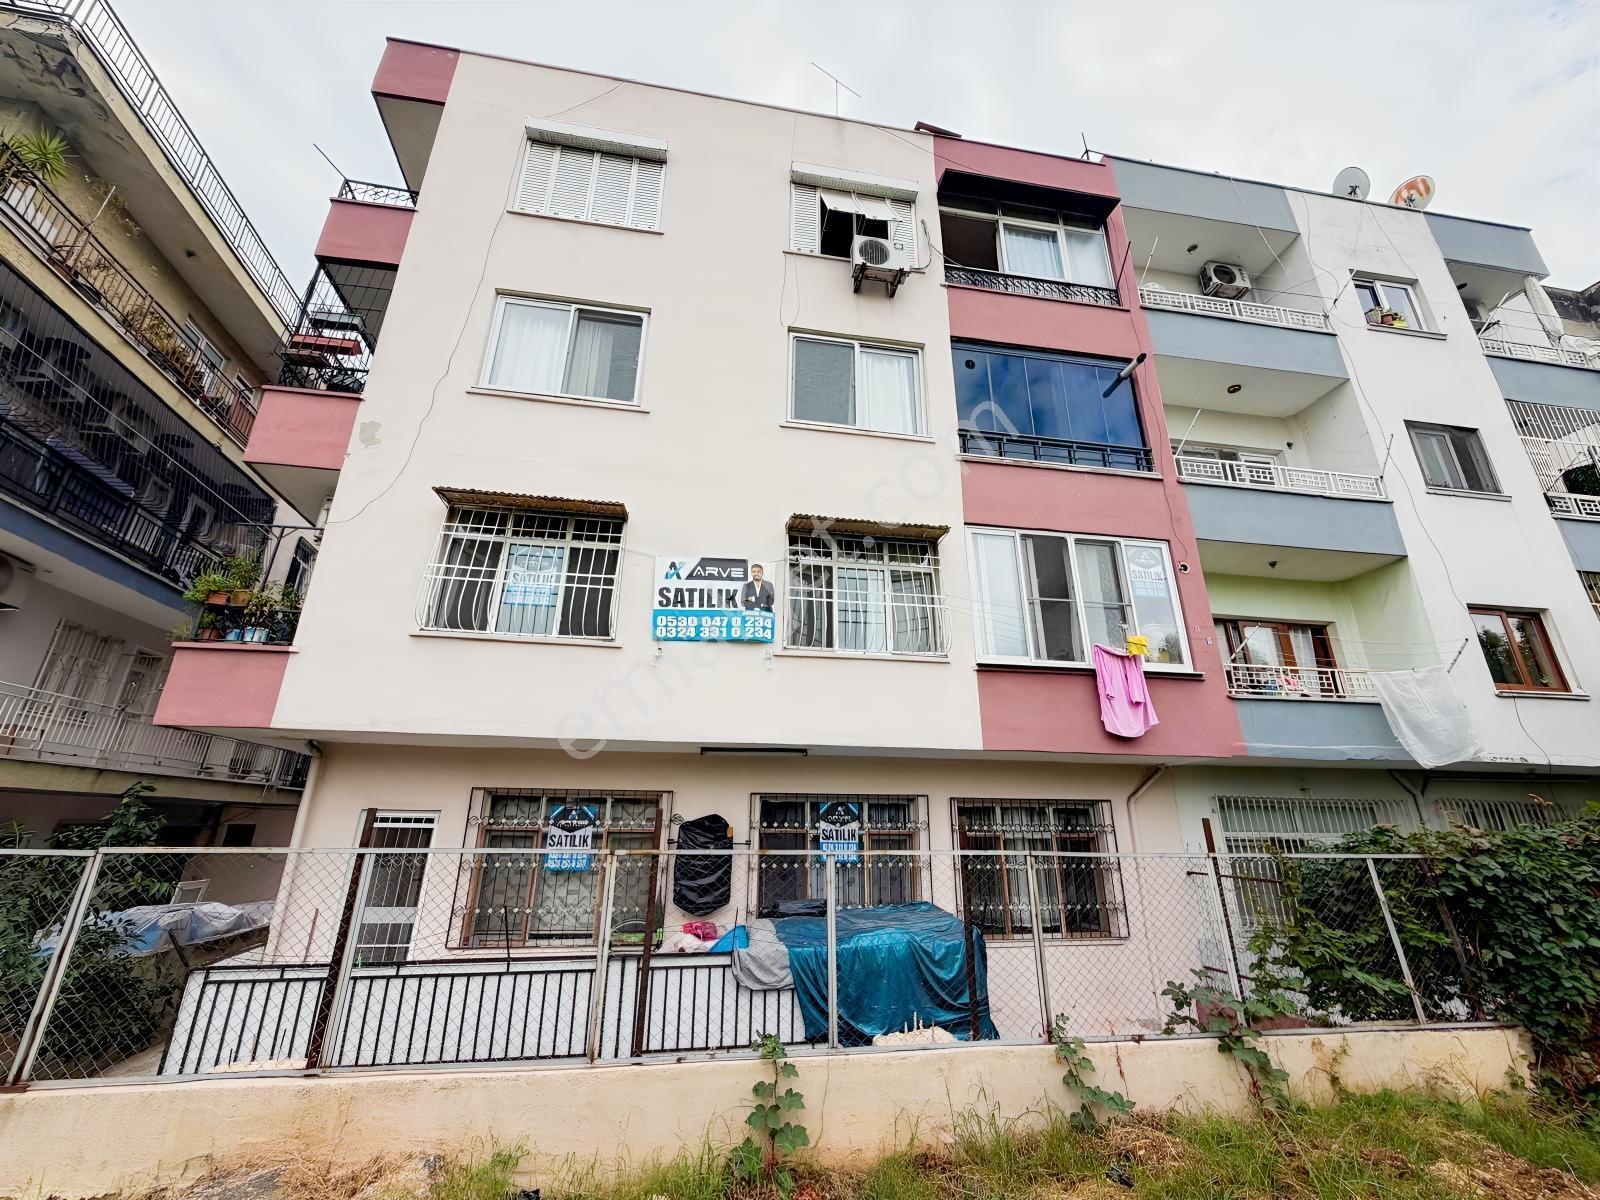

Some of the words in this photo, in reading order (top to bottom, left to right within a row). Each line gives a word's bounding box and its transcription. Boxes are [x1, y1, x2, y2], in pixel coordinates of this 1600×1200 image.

[692, 566, 745, 578] ARVE
[658, 586, 739, 609] SATILIK
[656, 615, 698, 627] 0530
[701, 616, 729, 628] 047
[731, 616, 742, 628] 0
[744, 617, 772, 630] 234
[656, 627, 696, 638] 0324
[699, 627, 727, 638] 331
[730, 627, 741, 638] 0
[744, 627, 772, 640] 234
[548, 834, 590, 848] SATILIK
[821, 828, 857, 841] SATILIK
